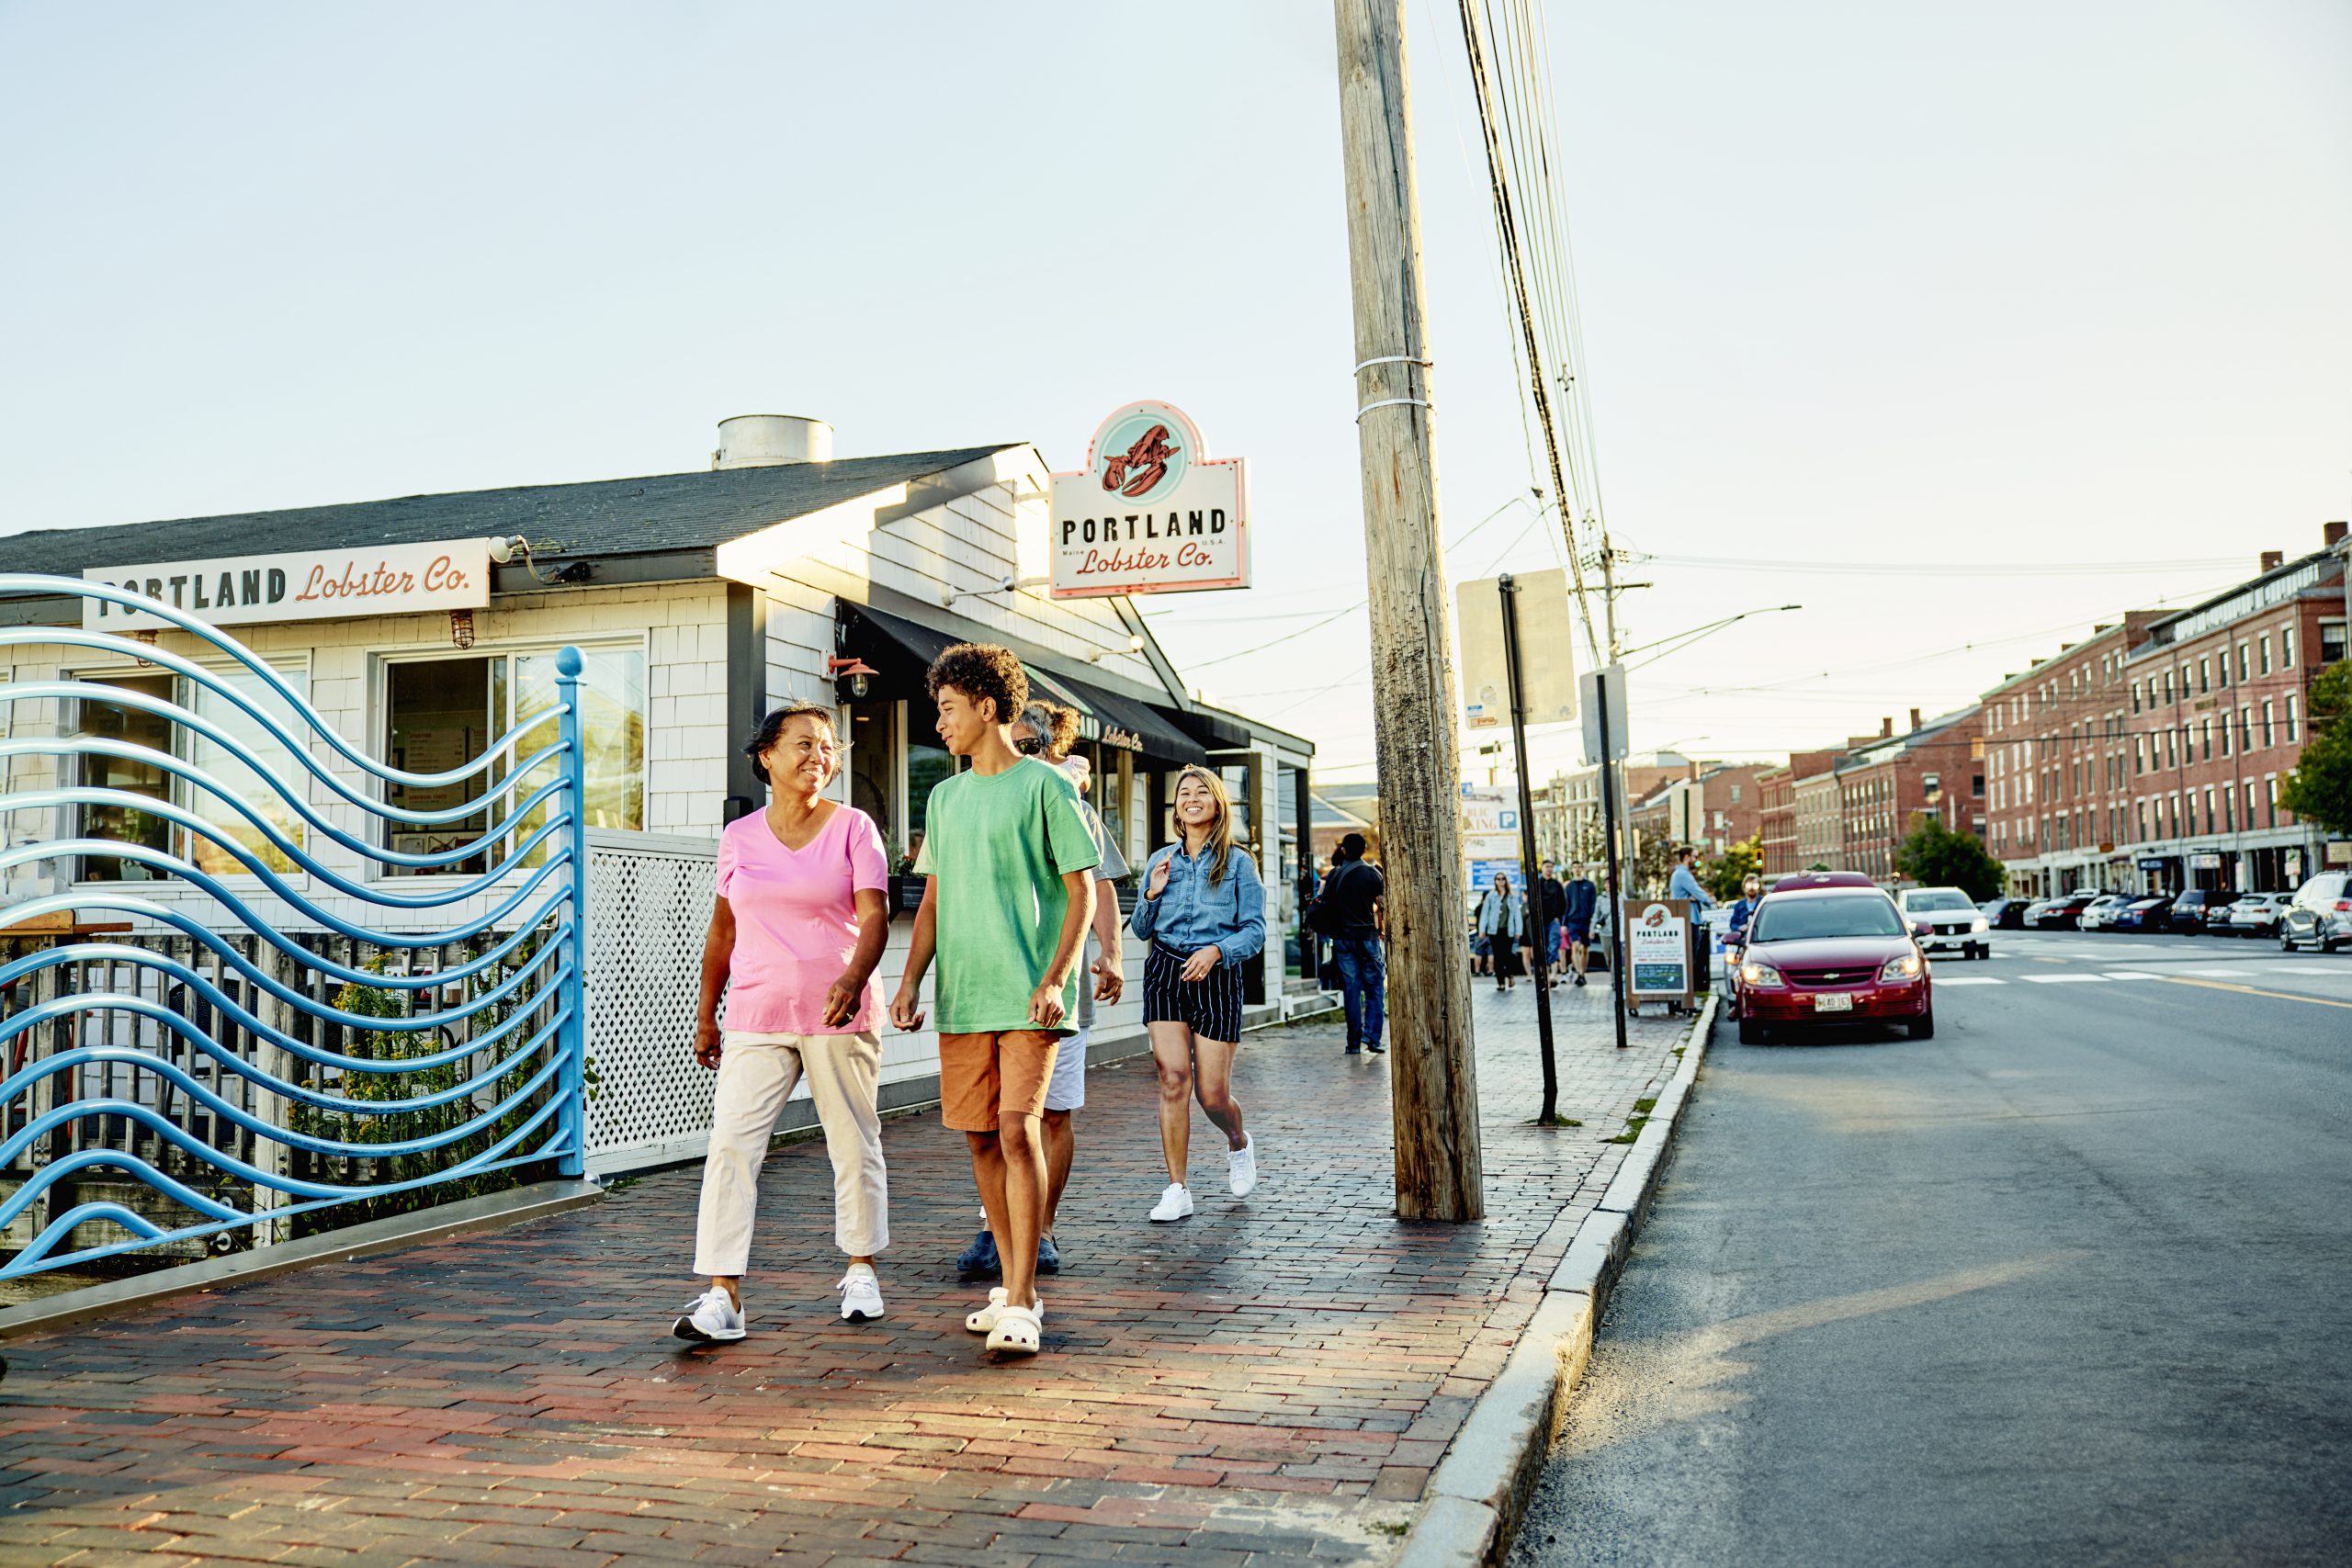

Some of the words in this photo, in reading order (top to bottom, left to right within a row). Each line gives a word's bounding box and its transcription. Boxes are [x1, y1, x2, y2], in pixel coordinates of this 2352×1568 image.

[1061, 508, 1226, 546] PORTLAND
[1202, 538, 1226, 547] U.S.A.
[1076, 546, 1170, 575] Lobster
[1177, 542, 1214, 567] Co.
[294, 560, 414, 602] Lobster
[424, 555, 469, 592] Co.
